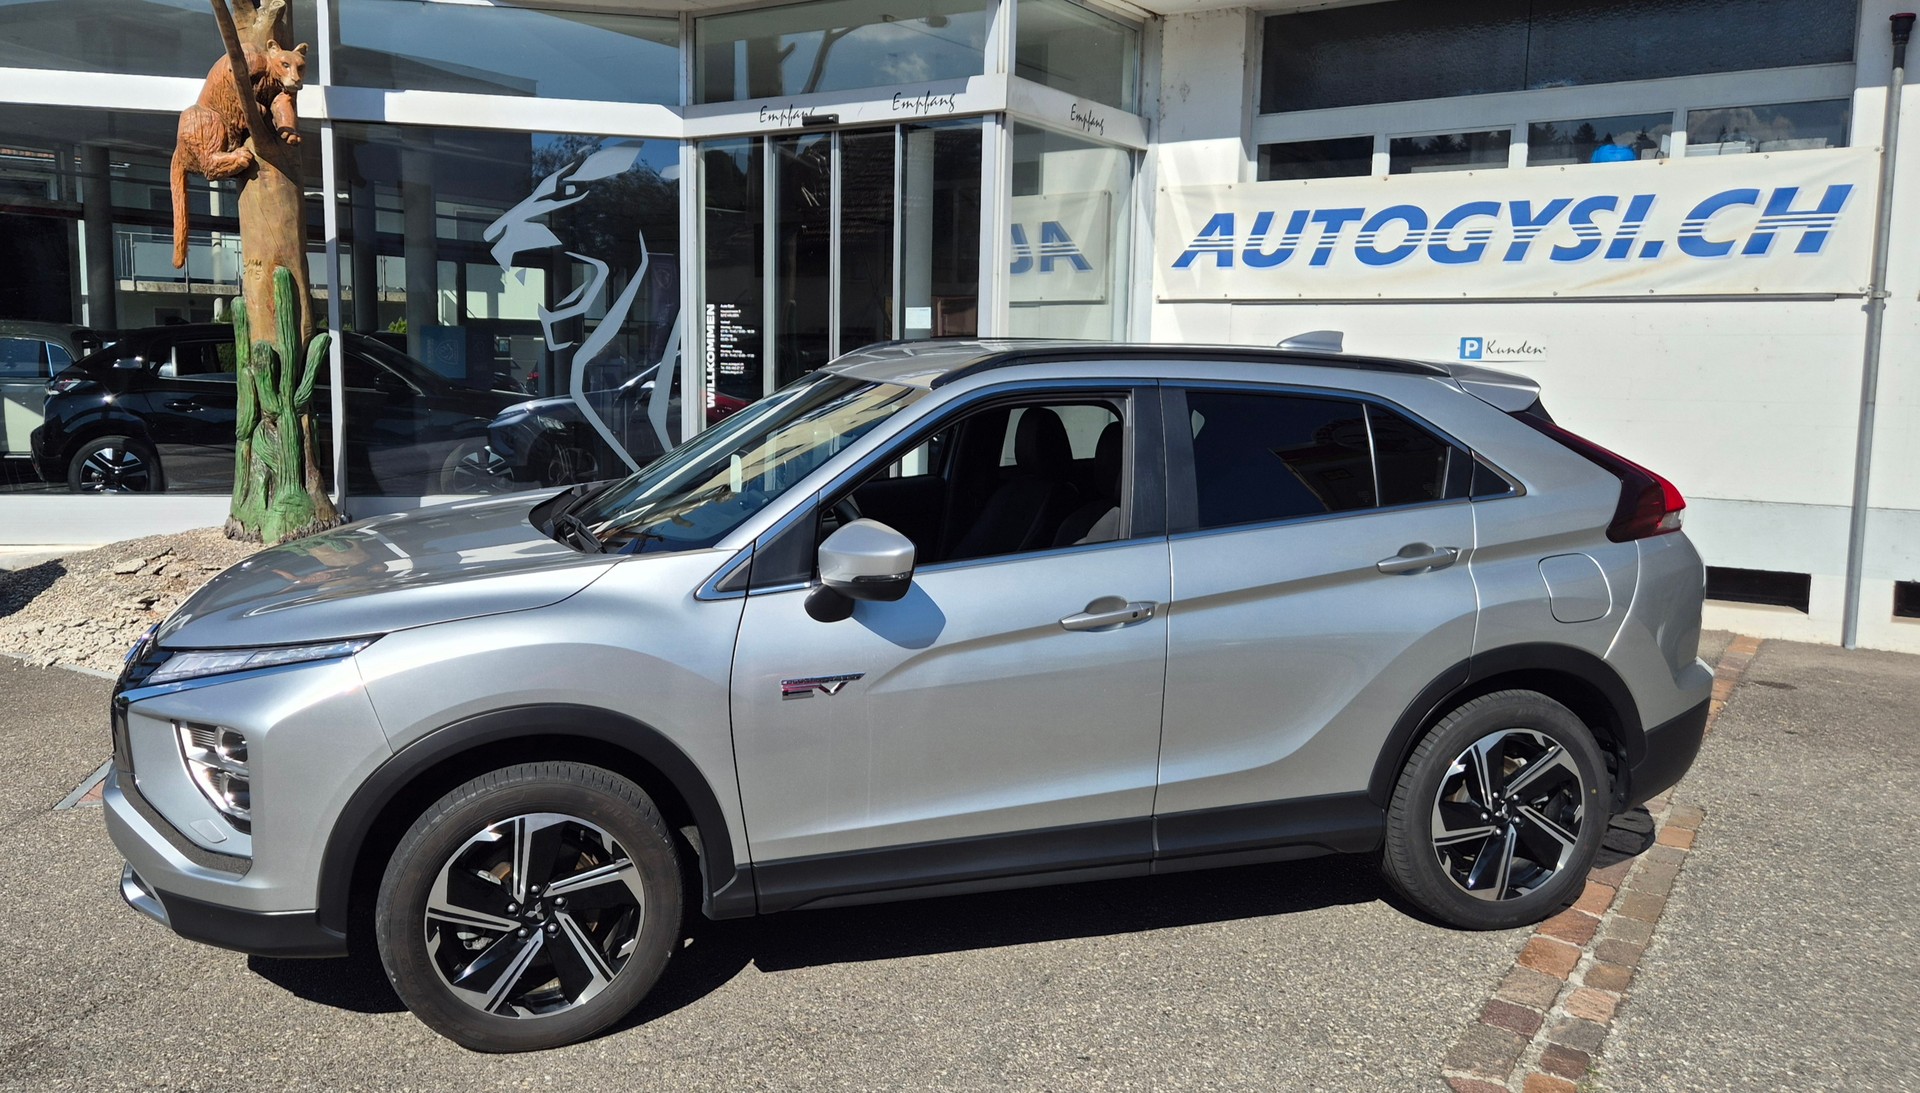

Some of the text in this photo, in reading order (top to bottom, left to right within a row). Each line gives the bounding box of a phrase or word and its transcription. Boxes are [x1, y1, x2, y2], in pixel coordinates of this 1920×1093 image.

[892, 90, 956, 114] Empfang
[1070, 103, 1104, 136] Empfang
[1170, 183, 1854, 268] AUTOGYSI.CH
[706, 304, 716, 408] WILLKOMMEN
[1464, 339, 1543, 357] P Kunden
